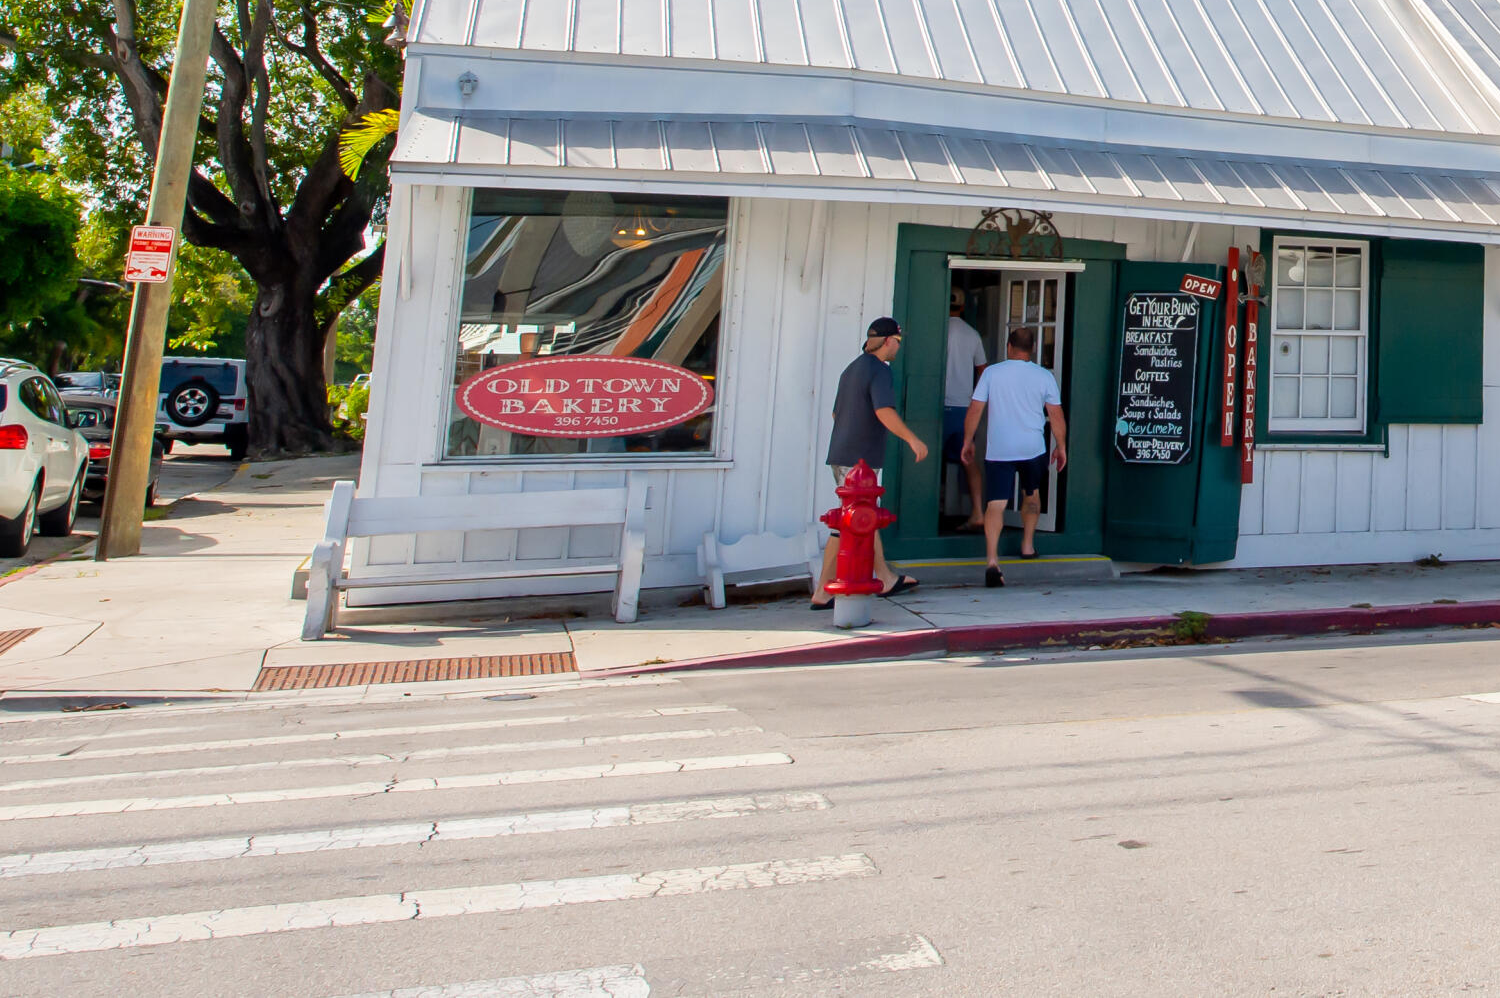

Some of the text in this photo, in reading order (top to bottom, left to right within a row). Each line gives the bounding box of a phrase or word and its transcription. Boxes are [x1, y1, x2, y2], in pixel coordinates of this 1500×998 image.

[138, 231, 170, 239] WARNING
[1184, 278, 1217, 295] OPEN
[1171, 297, 1197, 316] BUNS
[1142, 315, 1151, 328] IN
[1126, 331, 1173, 344] BREAKFAST
[1133, 345, 1177, 357] Sandwiches
[1151, 356, 1182, 368] Pastries
[1135, 368, 1170, 382] COFFEES
[1224, 325, 1237, 436] OPEN
[486, 378, 683, 395] OLD TOWN
[1122, 383, 1151, 394] LUNCH
[1244, 322, 1257, 462] BAKERY
[499, 397, 673, 415] BAKERY
[1129, 396, 1175, 408] Sandwiches
[1123, 407, 1146, 420] Soups
[1153, 407, 1182, 420] Salads
[554, 415, 619, 427] 396 7450
